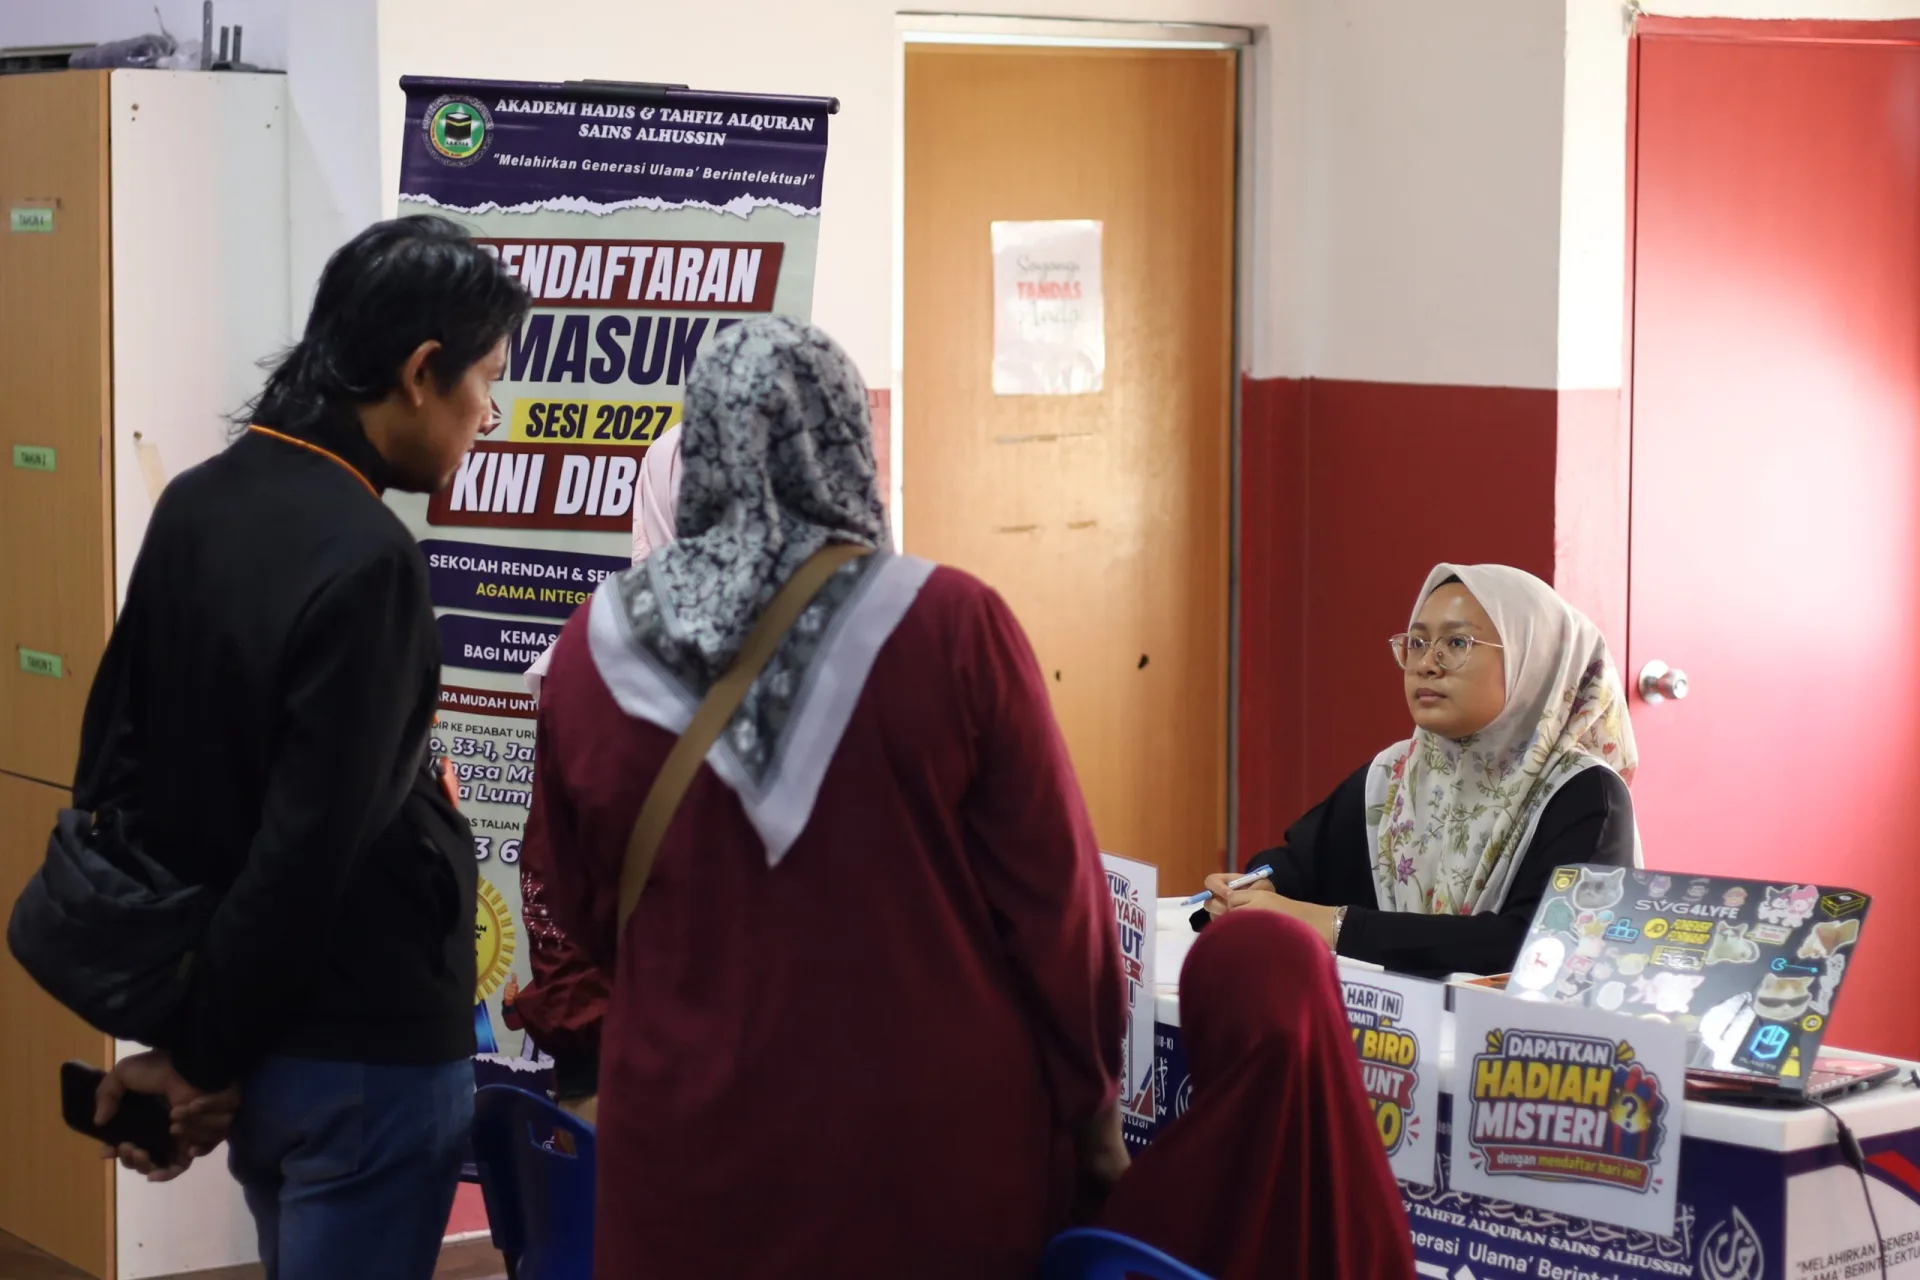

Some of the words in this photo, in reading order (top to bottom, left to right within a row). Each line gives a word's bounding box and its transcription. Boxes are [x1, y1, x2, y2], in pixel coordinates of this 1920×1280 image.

[495, 98, 577, 116] AKADEMI
[580, 102, 635, 119] HADIS
[640, 106, 655, 120] &
[659, 107, 724, 125] TAHFIZ
[728, 112, 815, 132] ALQURAN
[578, 123, 631, 140] SAINS
[635, 129, 726, 147] ALHUSSIN
[581, 159, 646, 175] Generasi
[501, 314, 743, 386] MASUK
[525, 402, 588, 438] SESI
[593, 405, 672, 440] 2027
[450, 452, 545, 514] KINI
[554, 454, 644, 516] DIB
[429, 554, 498, 574] SEKOLAH
[501, 561, 568, 580] RENDAH
[571, 567, 583, 581] &
[476, 582, 536, 600] AGAMA
[540, 588, 593, 605] INTEG
[501, 629, 558, 647] KEMAS
[464, 644, 500, 661] BAGI
[504, 648, 541, 664] MUR
[439, 691, 458, 704] RA
[460, 693, 507, 710] MUDAH
[450, 723, 463, 733] KE
[466, 725, 514, 738] PEJABAT
[452, 736, 499, 762] 33-1,
[481, 819, 520, 832] TALIAN
[499, 839, 521, 864] 6
[1117, 922, 1143, 960] UT
[1346, 987, 1378, 1009] HARI
[1382, 994, 1400, 1016] INI
[1362, 1029, 1416, 1065] BIRD
[1508, 1035, 1610, 1066] DAPATKAN
[1474, 1059, 1613, 1107] HADIAH
[1474, 1101, 1609, 1148] MISTERI
[1497, 1151, 1537, 1168] dengan
[1414, 1203, 1466, 1227] TAHFIZ
[1468, 1217, 1547, 1245] ALQURAN
[1549, 1236, 1600, 1258] SAINS
[1603, 1248, 1693, 1277] ALHUSSIN
